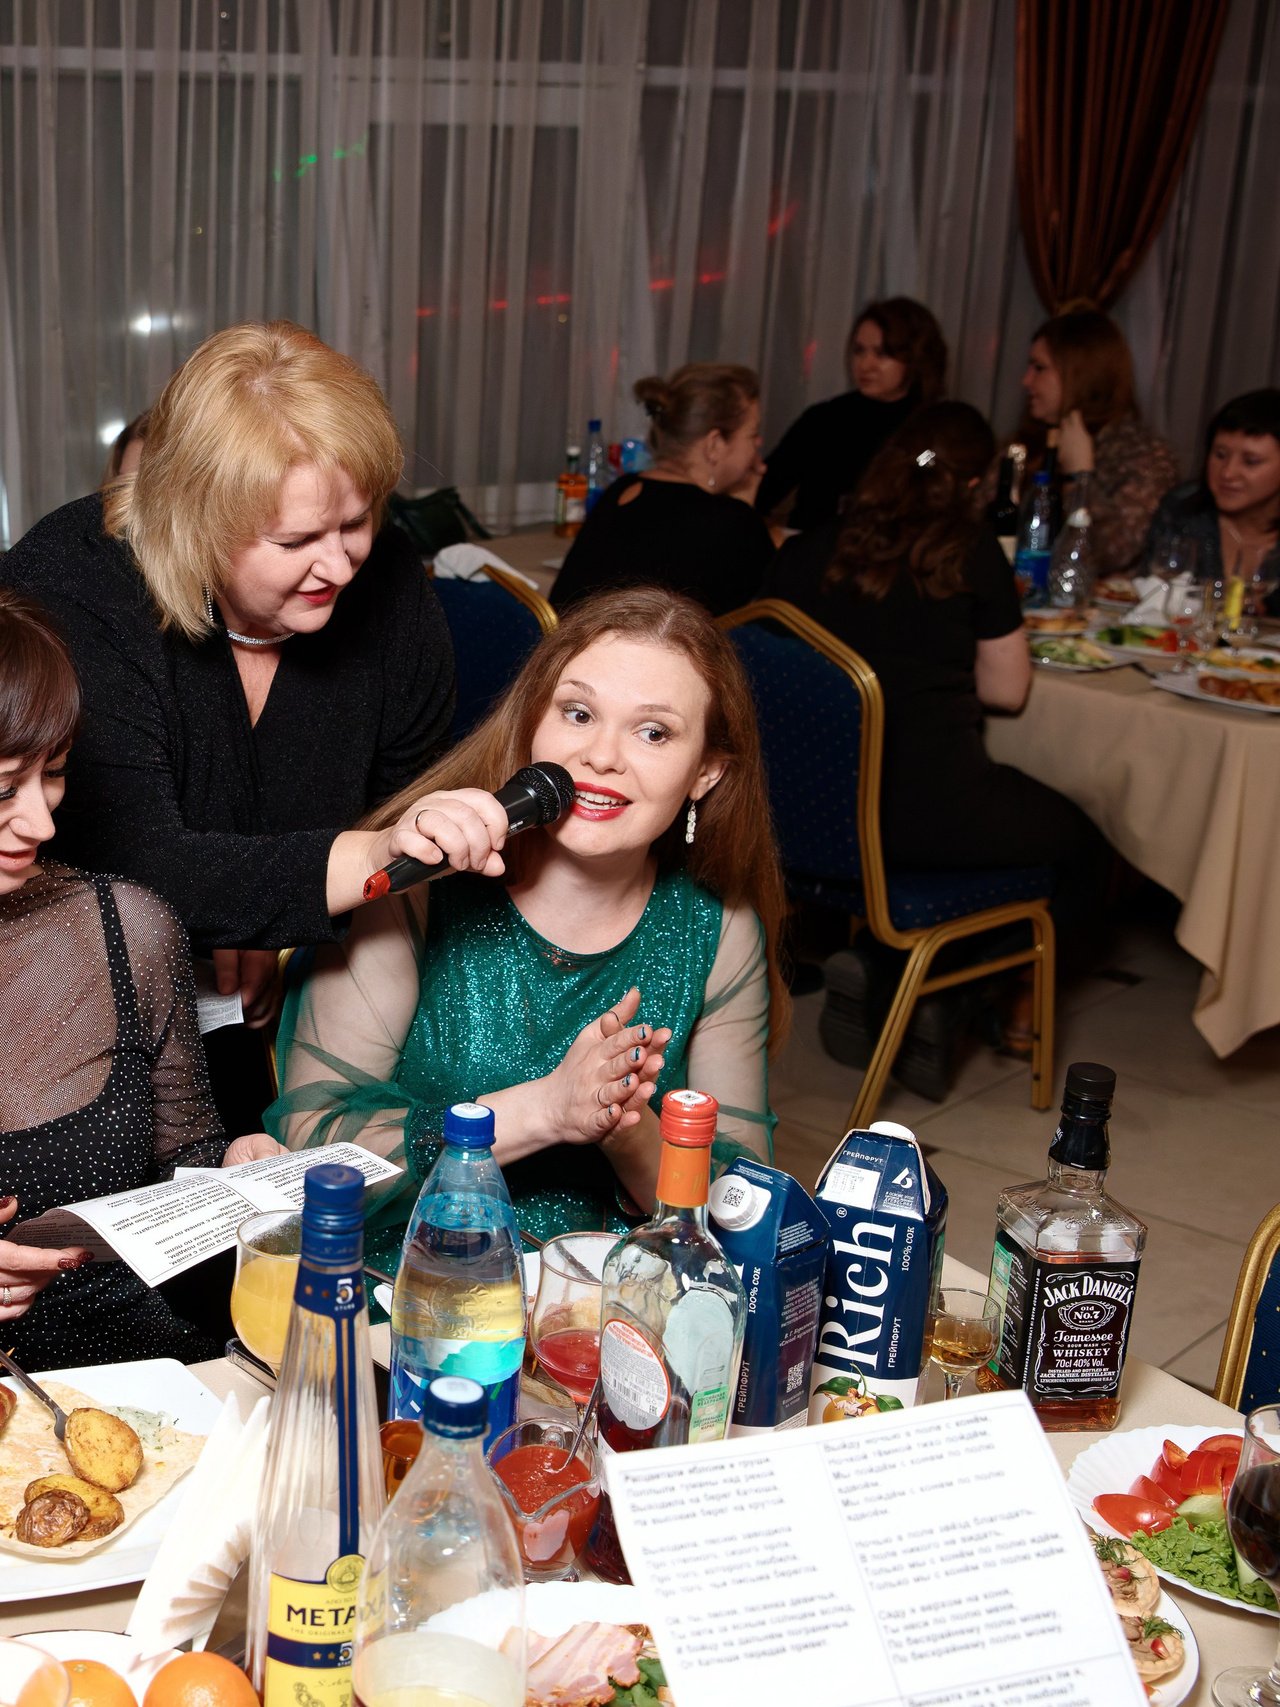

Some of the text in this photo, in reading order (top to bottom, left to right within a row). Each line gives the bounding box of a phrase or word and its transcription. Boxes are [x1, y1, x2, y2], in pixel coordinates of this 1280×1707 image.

[842, 1149, 884, 1163] ГРЕЙПФРУТ
[901, 1226, 915, 1272] 100% сок
[335, 1277, 354, 1305] 5
[748, 1266, 761, 1314] 100% сок
[817, 1223, 896, 1370] Rich
[1043, 1275, 1135, 1308] JACK DANIEL'S
[1073, 1311, 1101, 1320] No.7
[887, 1316, 902, 1368] ГРЕЙПФРУТ
[1054, 1330, 1114, 1343] Tennessee
[1053, 1347, 1111, 1358] WHISKEY
[1055, 1357, 1105, 1368] 70cl 40% Vol.
[737, 1360, 750, 1413] ГРЕЙПФРУТ
